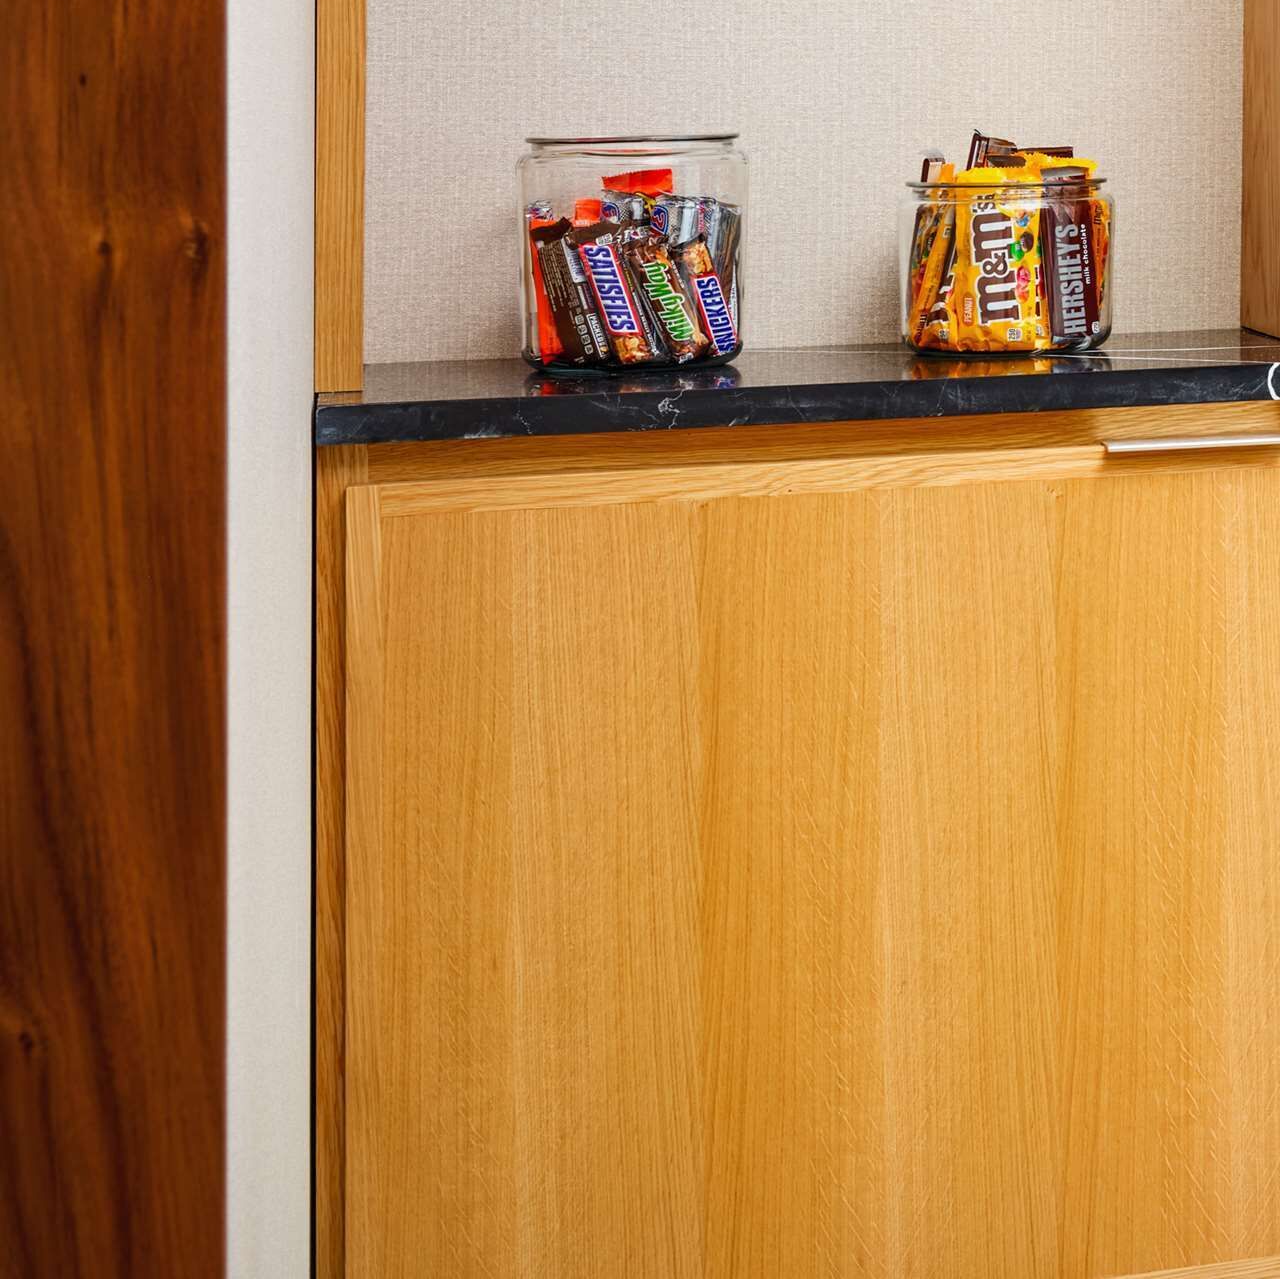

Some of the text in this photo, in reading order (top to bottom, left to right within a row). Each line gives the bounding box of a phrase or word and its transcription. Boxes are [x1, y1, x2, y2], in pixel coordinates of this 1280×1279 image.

[584, 244, 636, 333] SATISFIES
[1056, 223, 1087, 335] HERSHEY'S
[1080, 223, 1091, 285] milk chocolate
[697, 276, 737, 355] SNICKERS
